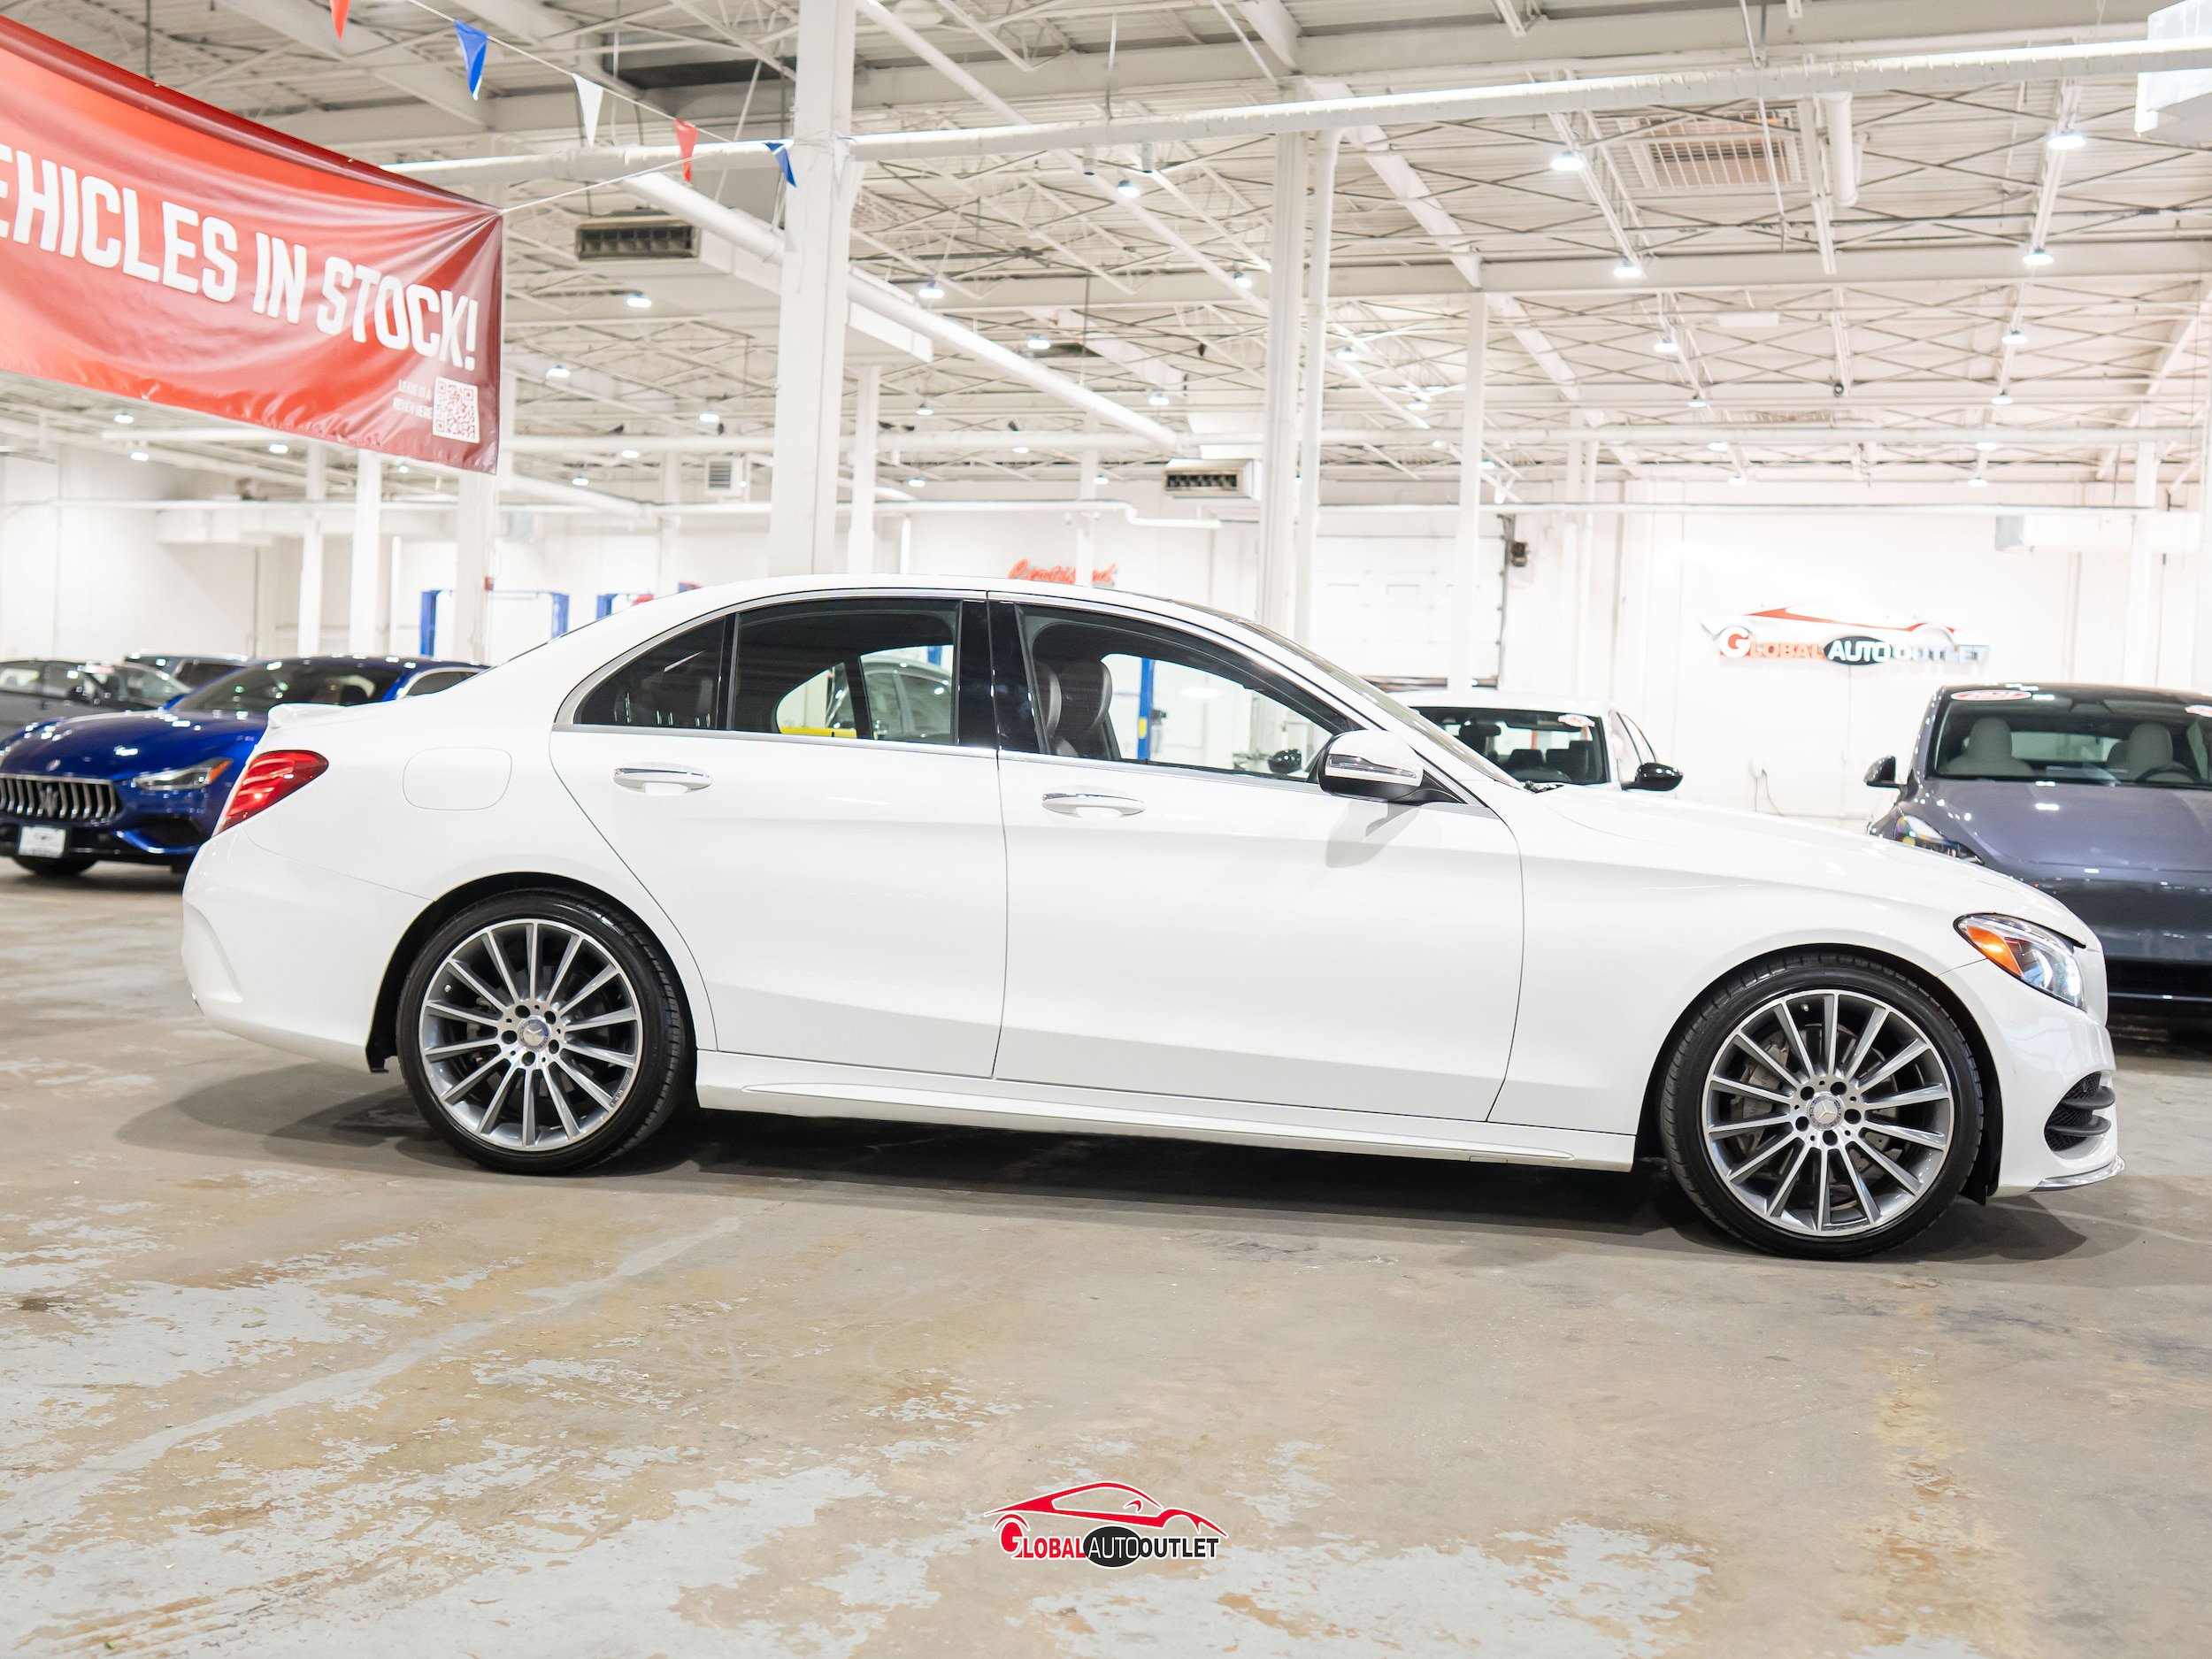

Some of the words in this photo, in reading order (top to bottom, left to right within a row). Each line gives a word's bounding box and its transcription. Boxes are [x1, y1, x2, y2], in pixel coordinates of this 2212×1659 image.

[251, 232, 308, 325] IN
[316, 256, 479, 371] STOCK!
[1718, 626, 1825, 659] GLOBAL
[1827, 640, 1892, 663] AUTO
[1891, 645, 1989, 664] OUTLET
